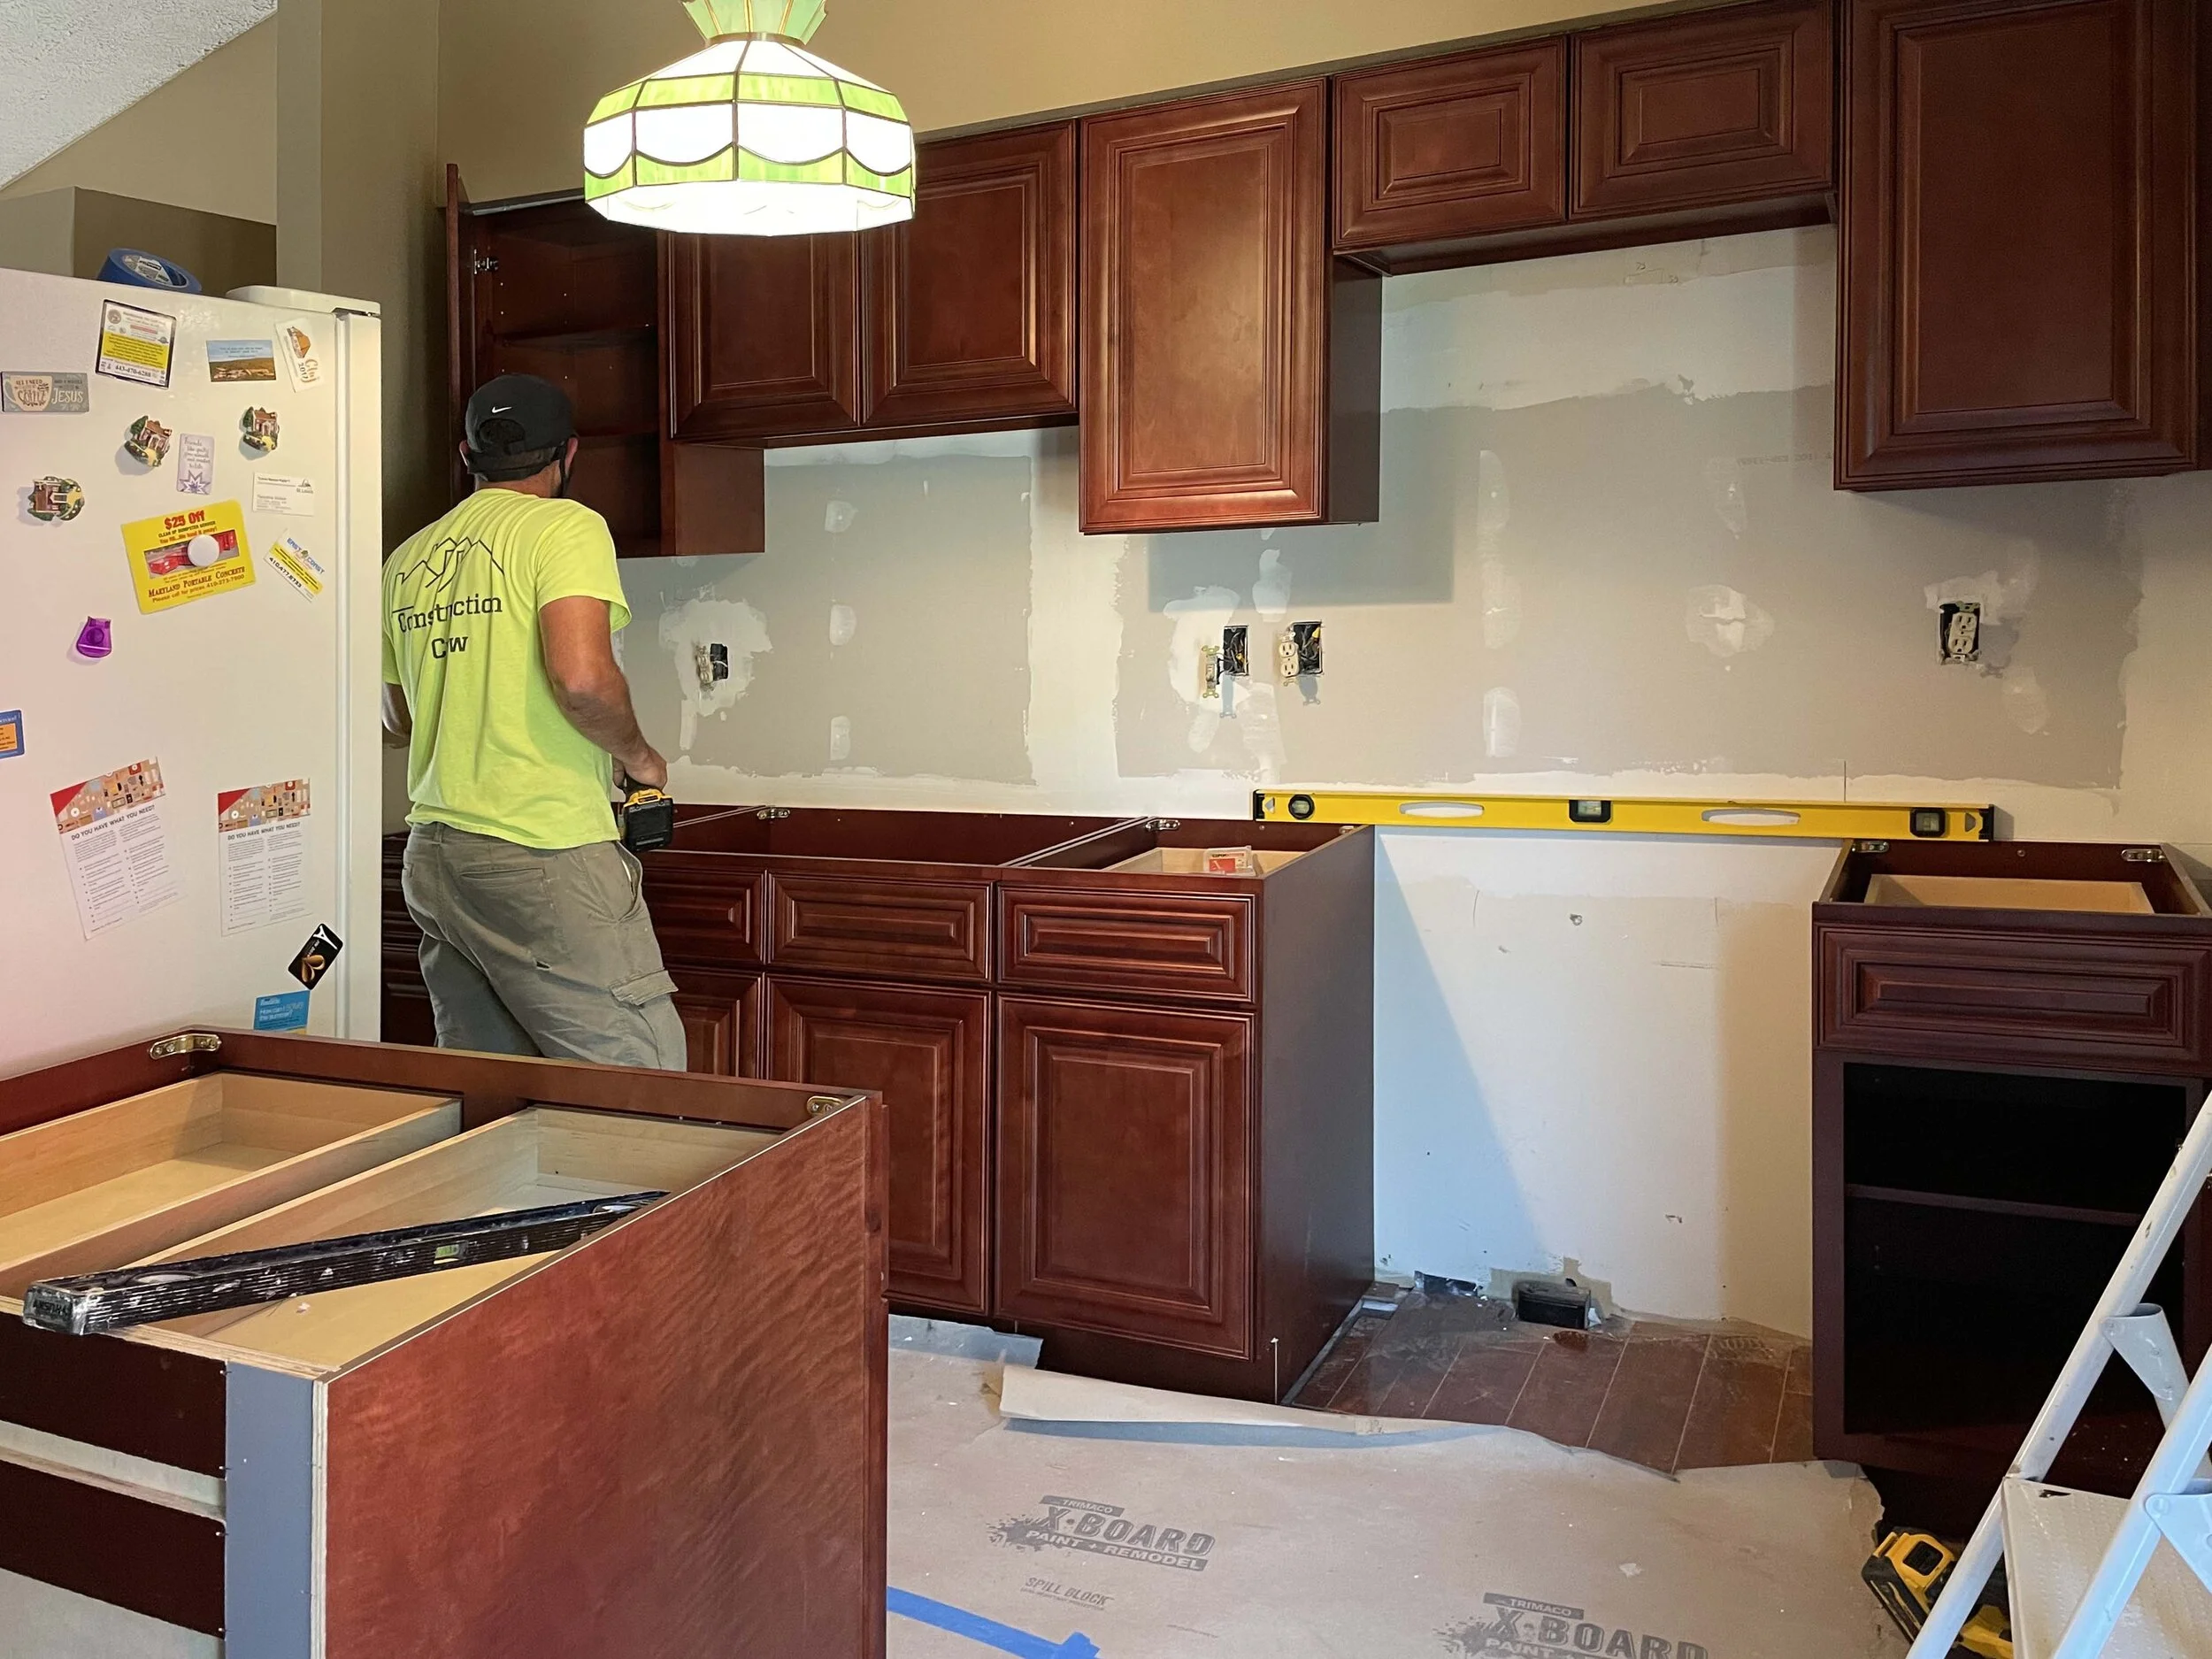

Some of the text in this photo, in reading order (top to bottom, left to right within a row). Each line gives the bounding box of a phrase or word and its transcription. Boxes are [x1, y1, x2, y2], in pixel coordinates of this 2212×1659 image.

[51, 388, 83, 404] JESUS
[165, 510, 204, 530] $25 Off
[149, 584, 180, 598] MARYLAND
[183, 575, 212, 588] PORTABLE
[215, 566, 245, 580] CONCRETE
[94, 823, 108, 832] HAVE
[109, 816, 125, 826] WHAT
[139, 804, 155, 815] NEED?
[1062, 1500, 1113, 1514] TRIMACO
[1026, 1530, 1084, 1547] PAINT
[1102, 1545, 1202, 1570] REMODEL
[1025, 1578, 1062, 1594] SPILL
[1064, 1587, 1111, 1605] BLOCK
[1510, 1599, 1572, 1617] TRIMACO
[1486, 1638, 1555, 1659] PAINT
